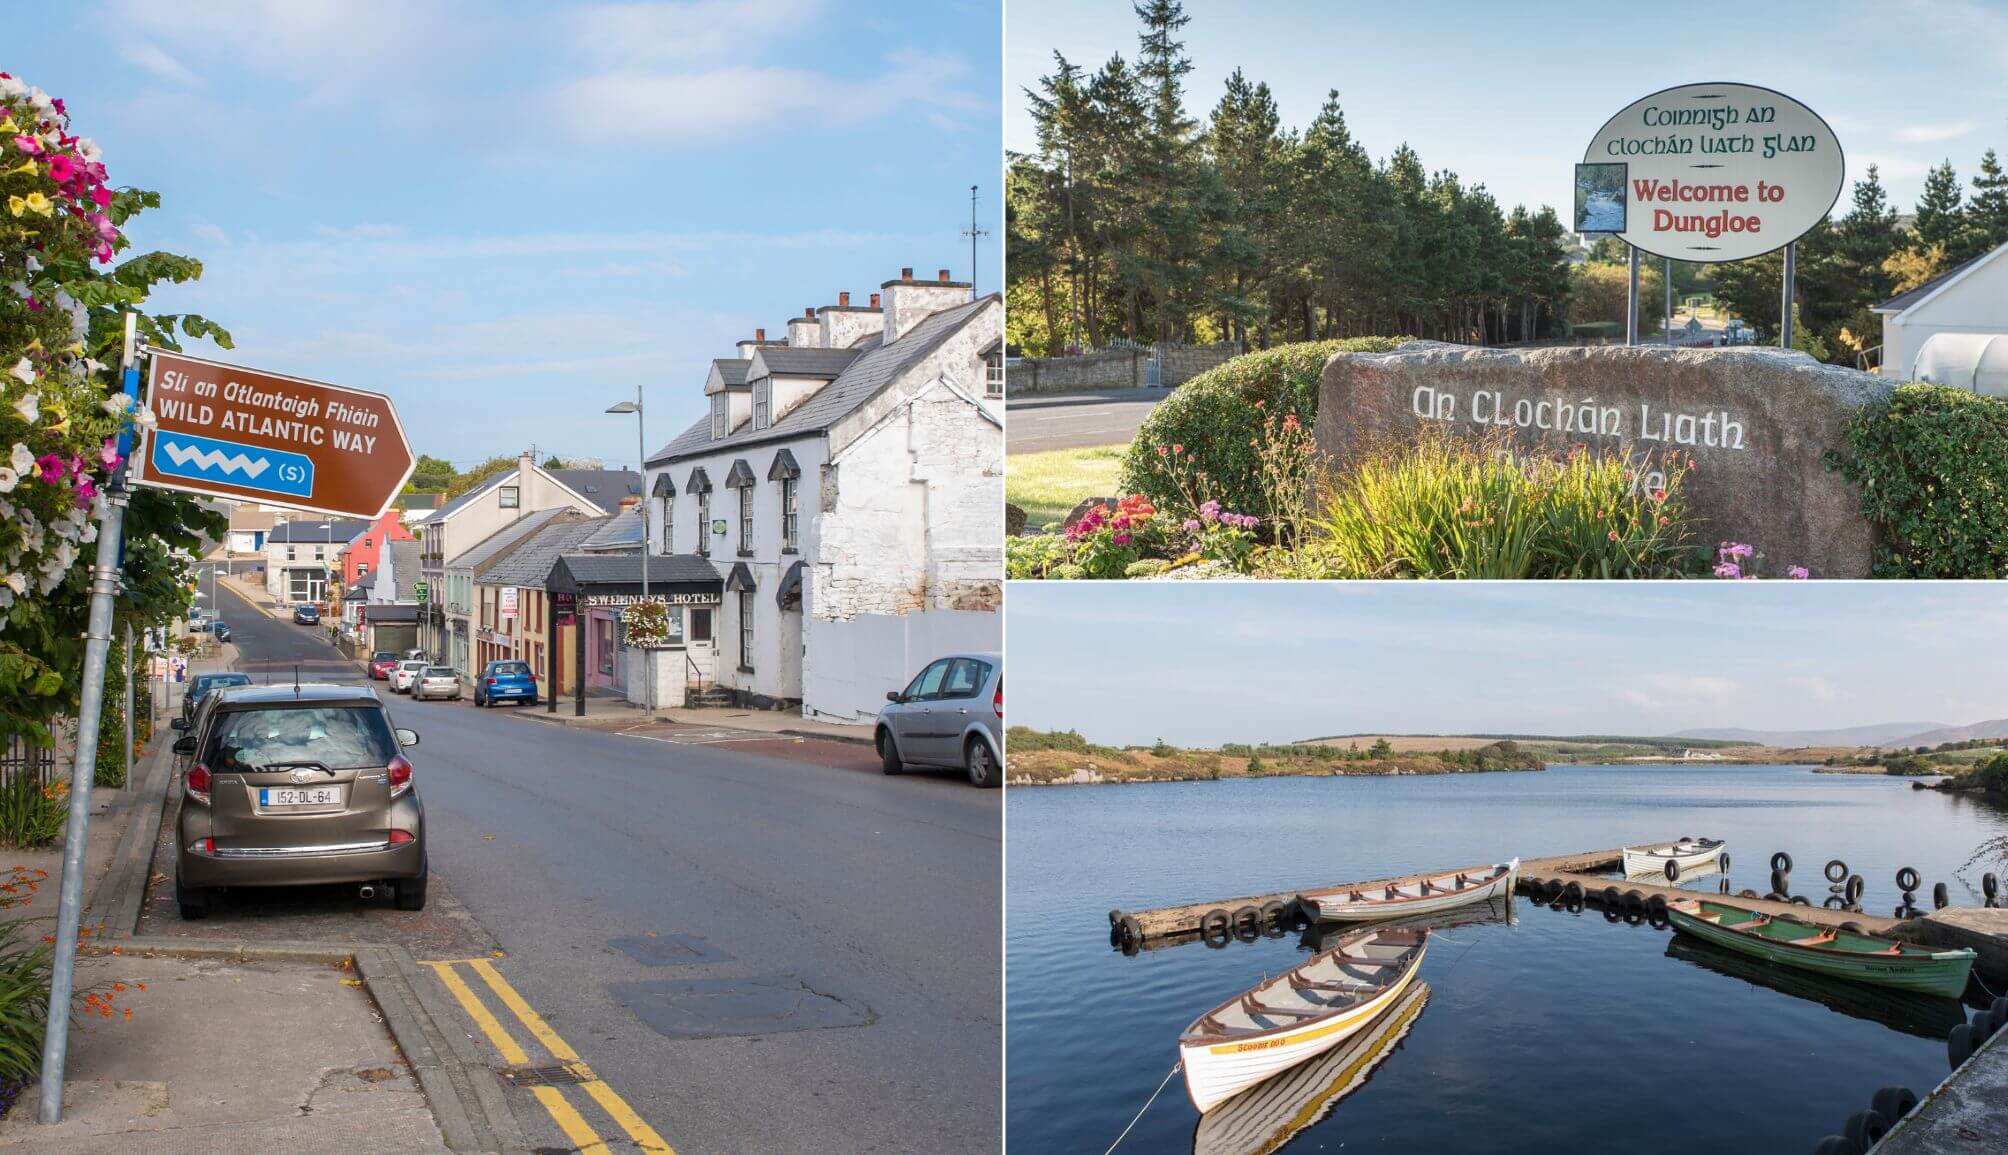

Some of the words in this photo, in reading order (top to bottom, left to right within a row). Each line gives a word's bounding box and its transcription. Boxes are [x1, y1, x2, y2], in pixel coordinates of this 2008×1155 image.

[1633, 179, 1749, 202] Welcome
[1757, 180, 1785, 202] to
[1653, 209, 1761, 238] Dungloe
[195, 380, 217, 398] an
[325, 401, 379, 428] Fhiáin
[159, 398, 214, 425] WILD
[221, 410, 324, 445] ATLANTIC
[333, 430, 377, 454] WAY
[1641, 404, 1745, 450] Liath
[278, 463, 306, 484] (S)
[673, 593, 720, 604] HOTEL
[277, 790, 331, 803] 152-DL-64
